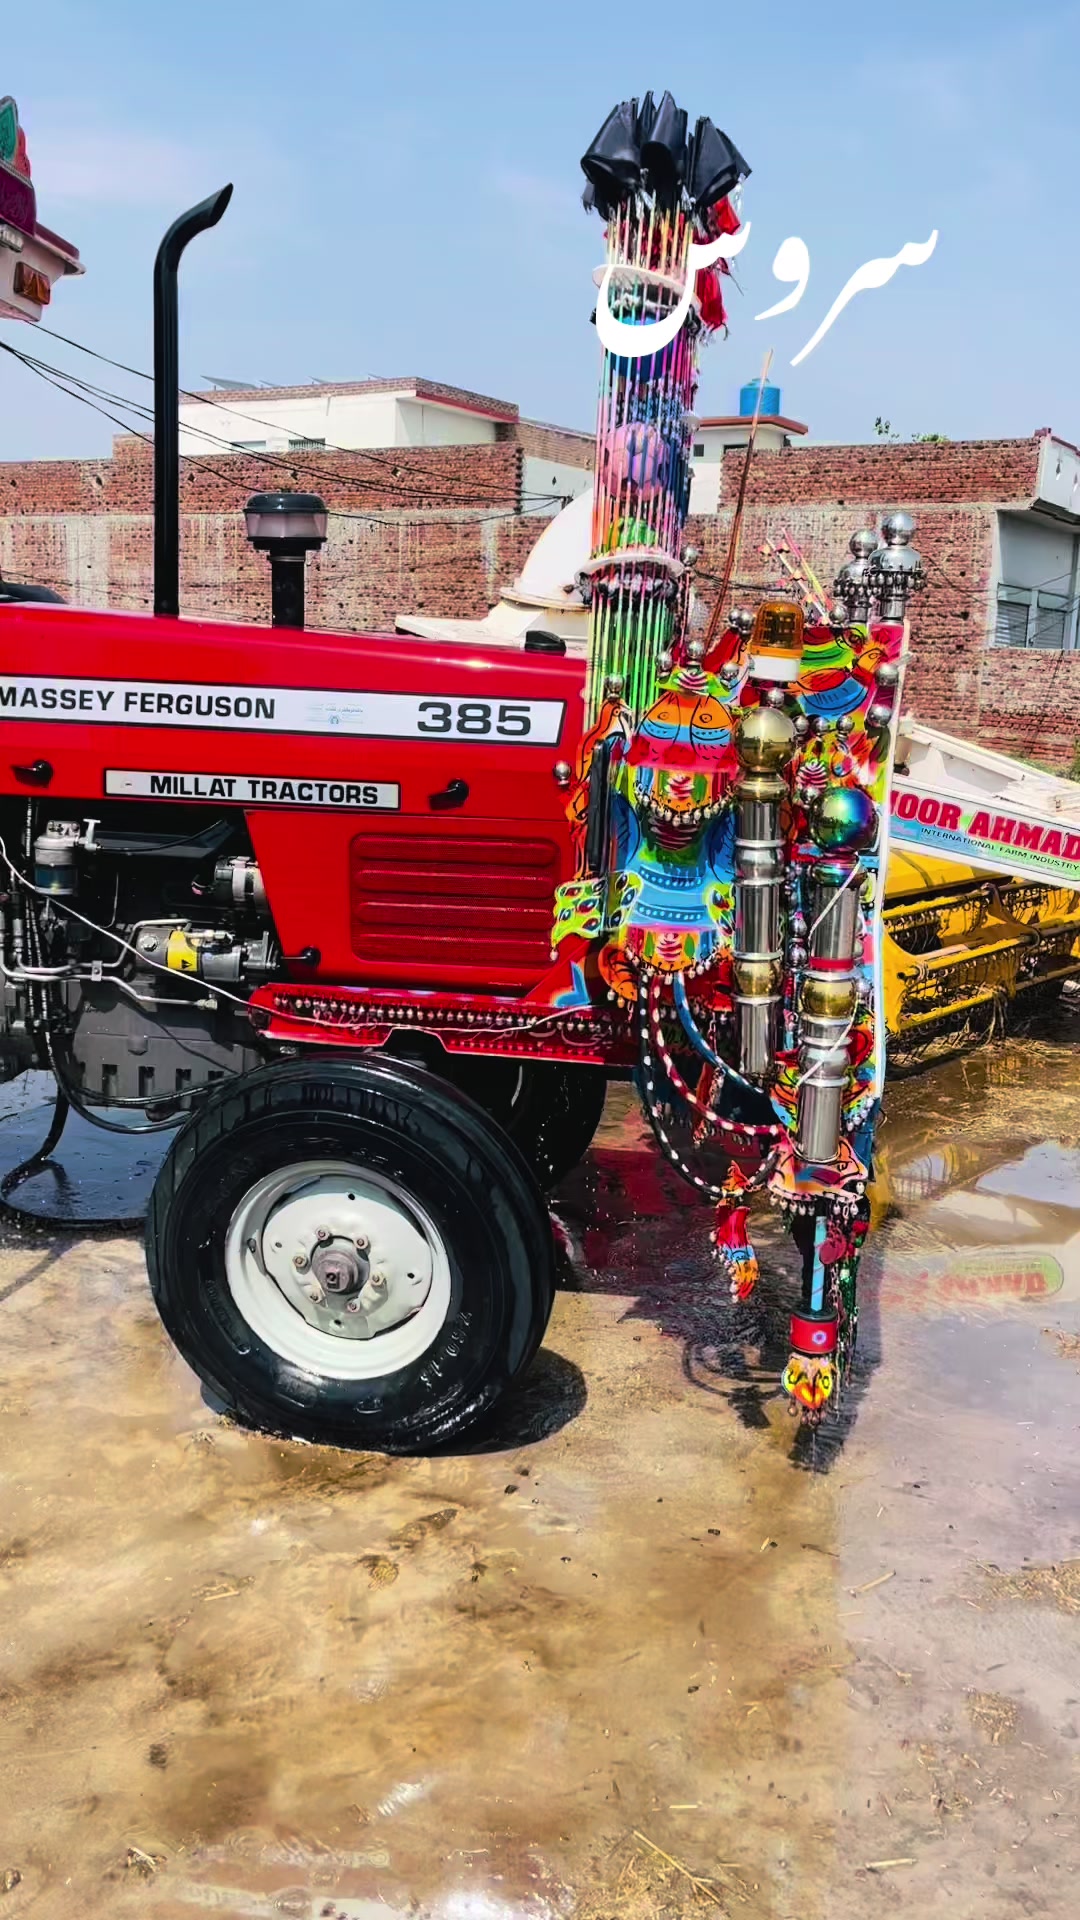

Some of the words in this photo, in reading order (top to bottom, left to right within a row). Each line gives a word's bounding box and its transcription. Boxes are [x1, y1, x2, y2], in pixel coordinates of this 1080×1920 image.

[0, 686, 115, 711] MASSEY
[124, 691, 275, 719] FERGUSON
[417, 701, 531, 736] 385
[150, 775, 237, 798] MILLAT
[248, 779, 379, 805] TRACTORS
[920, 827, 994, 850] INTERNATIONAL
[999, 845, 1027, 858] FARM
[1029, 852, 1080, 872] INDUSTRY
[967, 810, 1080, 861] AHMAD
